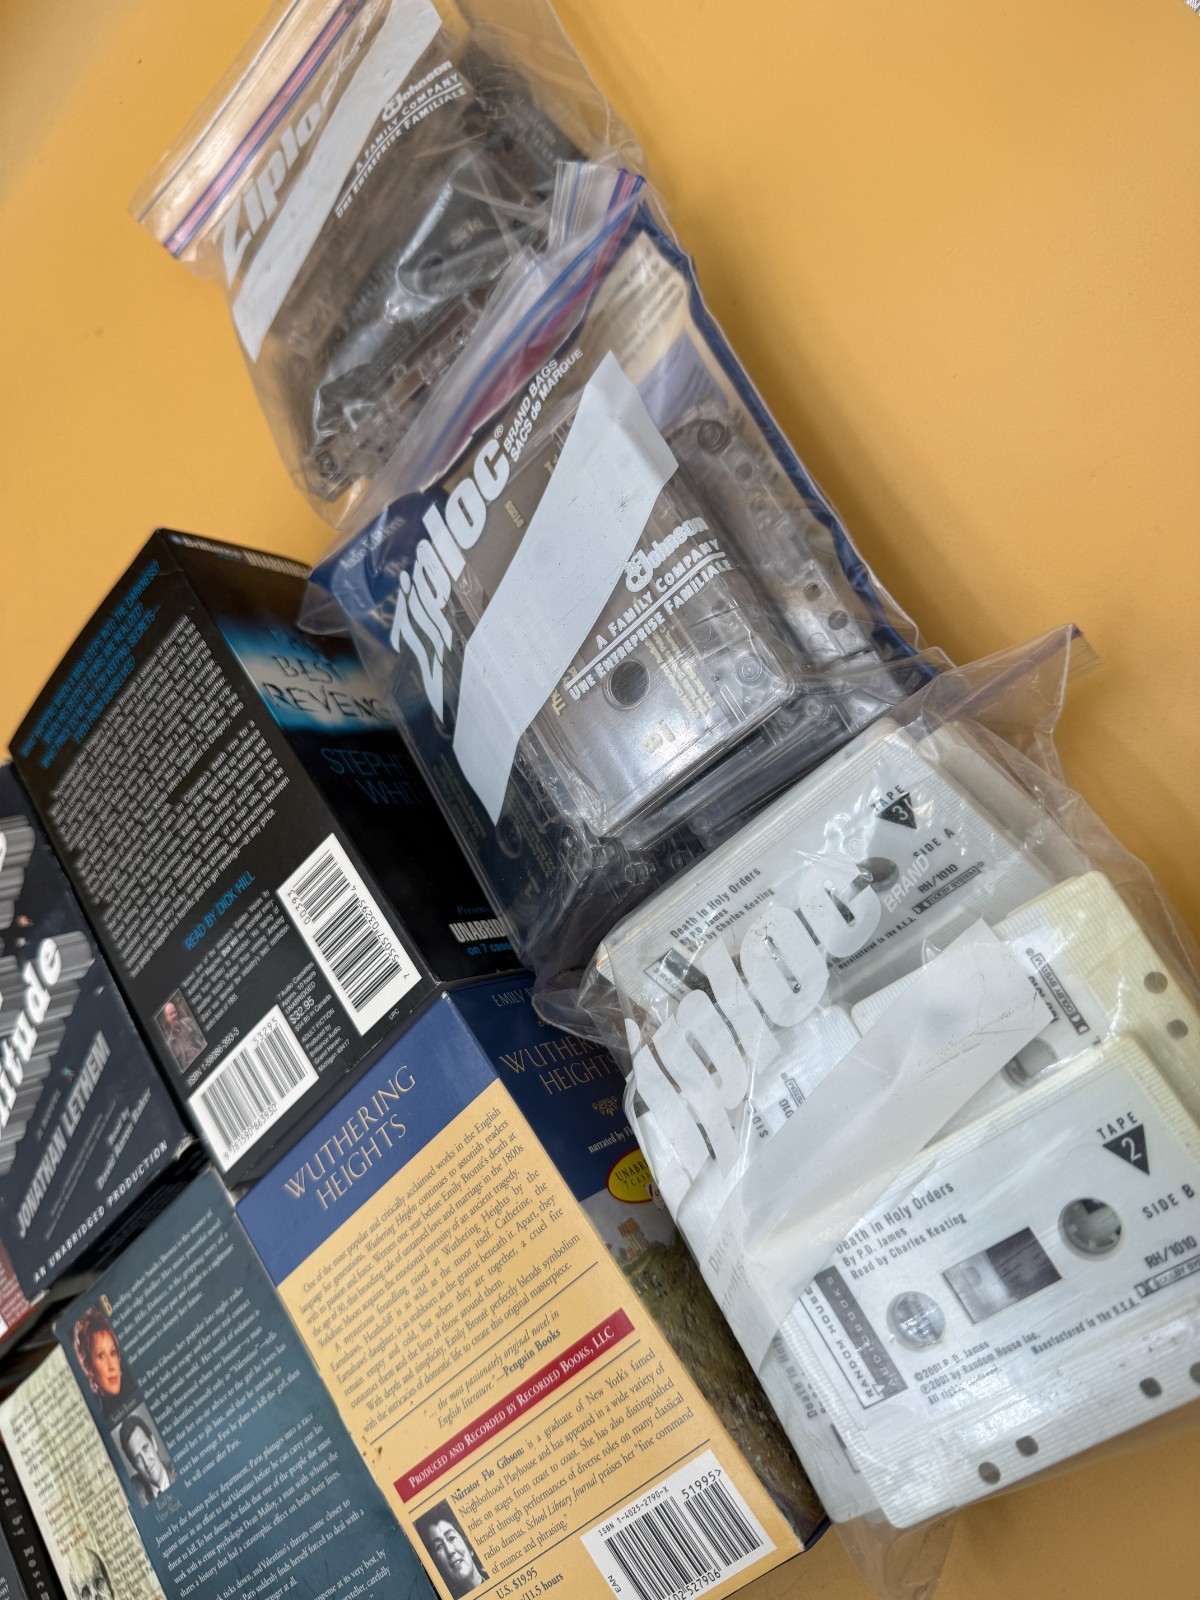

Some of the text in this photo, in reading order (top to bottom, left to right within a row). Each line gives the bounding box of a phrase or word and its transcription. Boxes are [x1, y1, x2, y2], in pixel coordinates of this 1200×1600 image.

[351, 128, 402, 194] ENTREPRISE
[402, 85, 467, 129] FAMILIALE
[352, 72, 459, 172] A FAMILY COMPANY
[502, 358, 558, 452] BRAND BAGS
[510, 347, 584, 462] SACS de MARQUE
[592, 538, 720, 650] A FAMILY COMPANY
[567, 672, 597, 701] UNE
[593, 610, 666, 678] ENTREPRISE
[662, 558, 734, 615] FAMILIALE
[273, 656, 343, 684] BEST
[202, 745, 272, 830] Alan Gregory becomes the
[870, 783, 904, 811] TAPE
[259, 804, 277, 828] price.
[890, 804, 908, 822] 3
[912, 826, 955, 859] SIDE A
[882, 854, 932, 913] BRAND
[916, 862, 959, 894] RH/1010
[185, 867, 255, 951] READ BY DICK HILL
[669, 866, 761, 939] Death in Holy Orders
[706, 930, 718, 941] by
[715, 907, 745, 932] Charles
[744, 886, 775, 911] Keating
[448, 917, 507, 942] UNABRID
[679, 935, 692, 946] By
[705, 907, 729, 928] James
[466, 945, 481, 955] on
[479, 943, 487, 952] 7
[280, 981, 293, 997] Audio
[292, 960, 314, 984] Cassettes
[1033, 955, 1057, 987] SYSTEM
[284, 980, 316, 1015] UNABRIDGED
[289, 994, 315, 1026] $32.95
[388, 1007, 400, 1021] UPC
[491, 990, 526, 1007] EMILY
[624, 847, 882, 1183] iploc
[1052, 986, 1074, 1013] DOLBY
[252, 1016, 278, 1046] 53295
[301, 1007, 335, 1044] ADULT FICTION
[186, 1025, 240, 1087] ISBN 1-59086-393-3
[13, 1125, 70, 1239] JONATHAN
[58, 1028, 113, 1136] LETHEM
[95, 1085, 154, 1190] David Aaron Baker
[106, 1104, 132, 1147] Read by
[283, 1062, 417, 1203] WUTHERING
[587, 1134, 617, 1154] narrated
[615, 1130, 626, 1144] by
[1096, 1110, 1139, 1140] TAPE
[314, 1111, 408, 1210] HEIGHTS
[378, 1105, 503, 1223] critically acclaimed works in the English
[1119, 1135, 1143, 1163] 2
[32, 1266, 47, 1284] AN
[46, 1204, 107, 1268] UNABRIDGED
[106, 1139, 169, 1208] PRODUCTION
[833, 1179, 955, 1255] Death in Holy Orders
[1141, 1182, 1196, 1220] SIDE B
[841, 1224, 908, 1269] By P.D. James
[849, 1209, 968, 1280] Read by Charles Keating
[1144, 1233, 1198, 1270] RH/1010
[804, 1285, 874, 1397] RANDOM HOUSE
[960, 1328, 1042, 1376] Random House Inc.
[961, 1337, 991, 1360] James
[784, 1365, 798, 1379] in
[408, 1324, 614, 1488] PRODUCED AND RECORDED BY RECORDED BOOKS, LLC
[791, 1380, 818, 1419] Death
[450, 1347, 656, 1504] Narrator Flo Gibson: is a graduate of New York's famed
[457, 1368, 657, 1520] Neighborhood Playhouse variety
[288, 1496, 352, 1548] threats come closer to
[597, 1484, 669, 1537] ISBN 1-4025-2790-X
[289, 1510, 360, 1567] herself forced deal with
[495, 1565, 539, 1600] U.S. $19.95
[540, 1569, 564, 1591] hours
[606, 1573, 622, 1594] EAN
[685, 1567, 722, 1596] 527906
